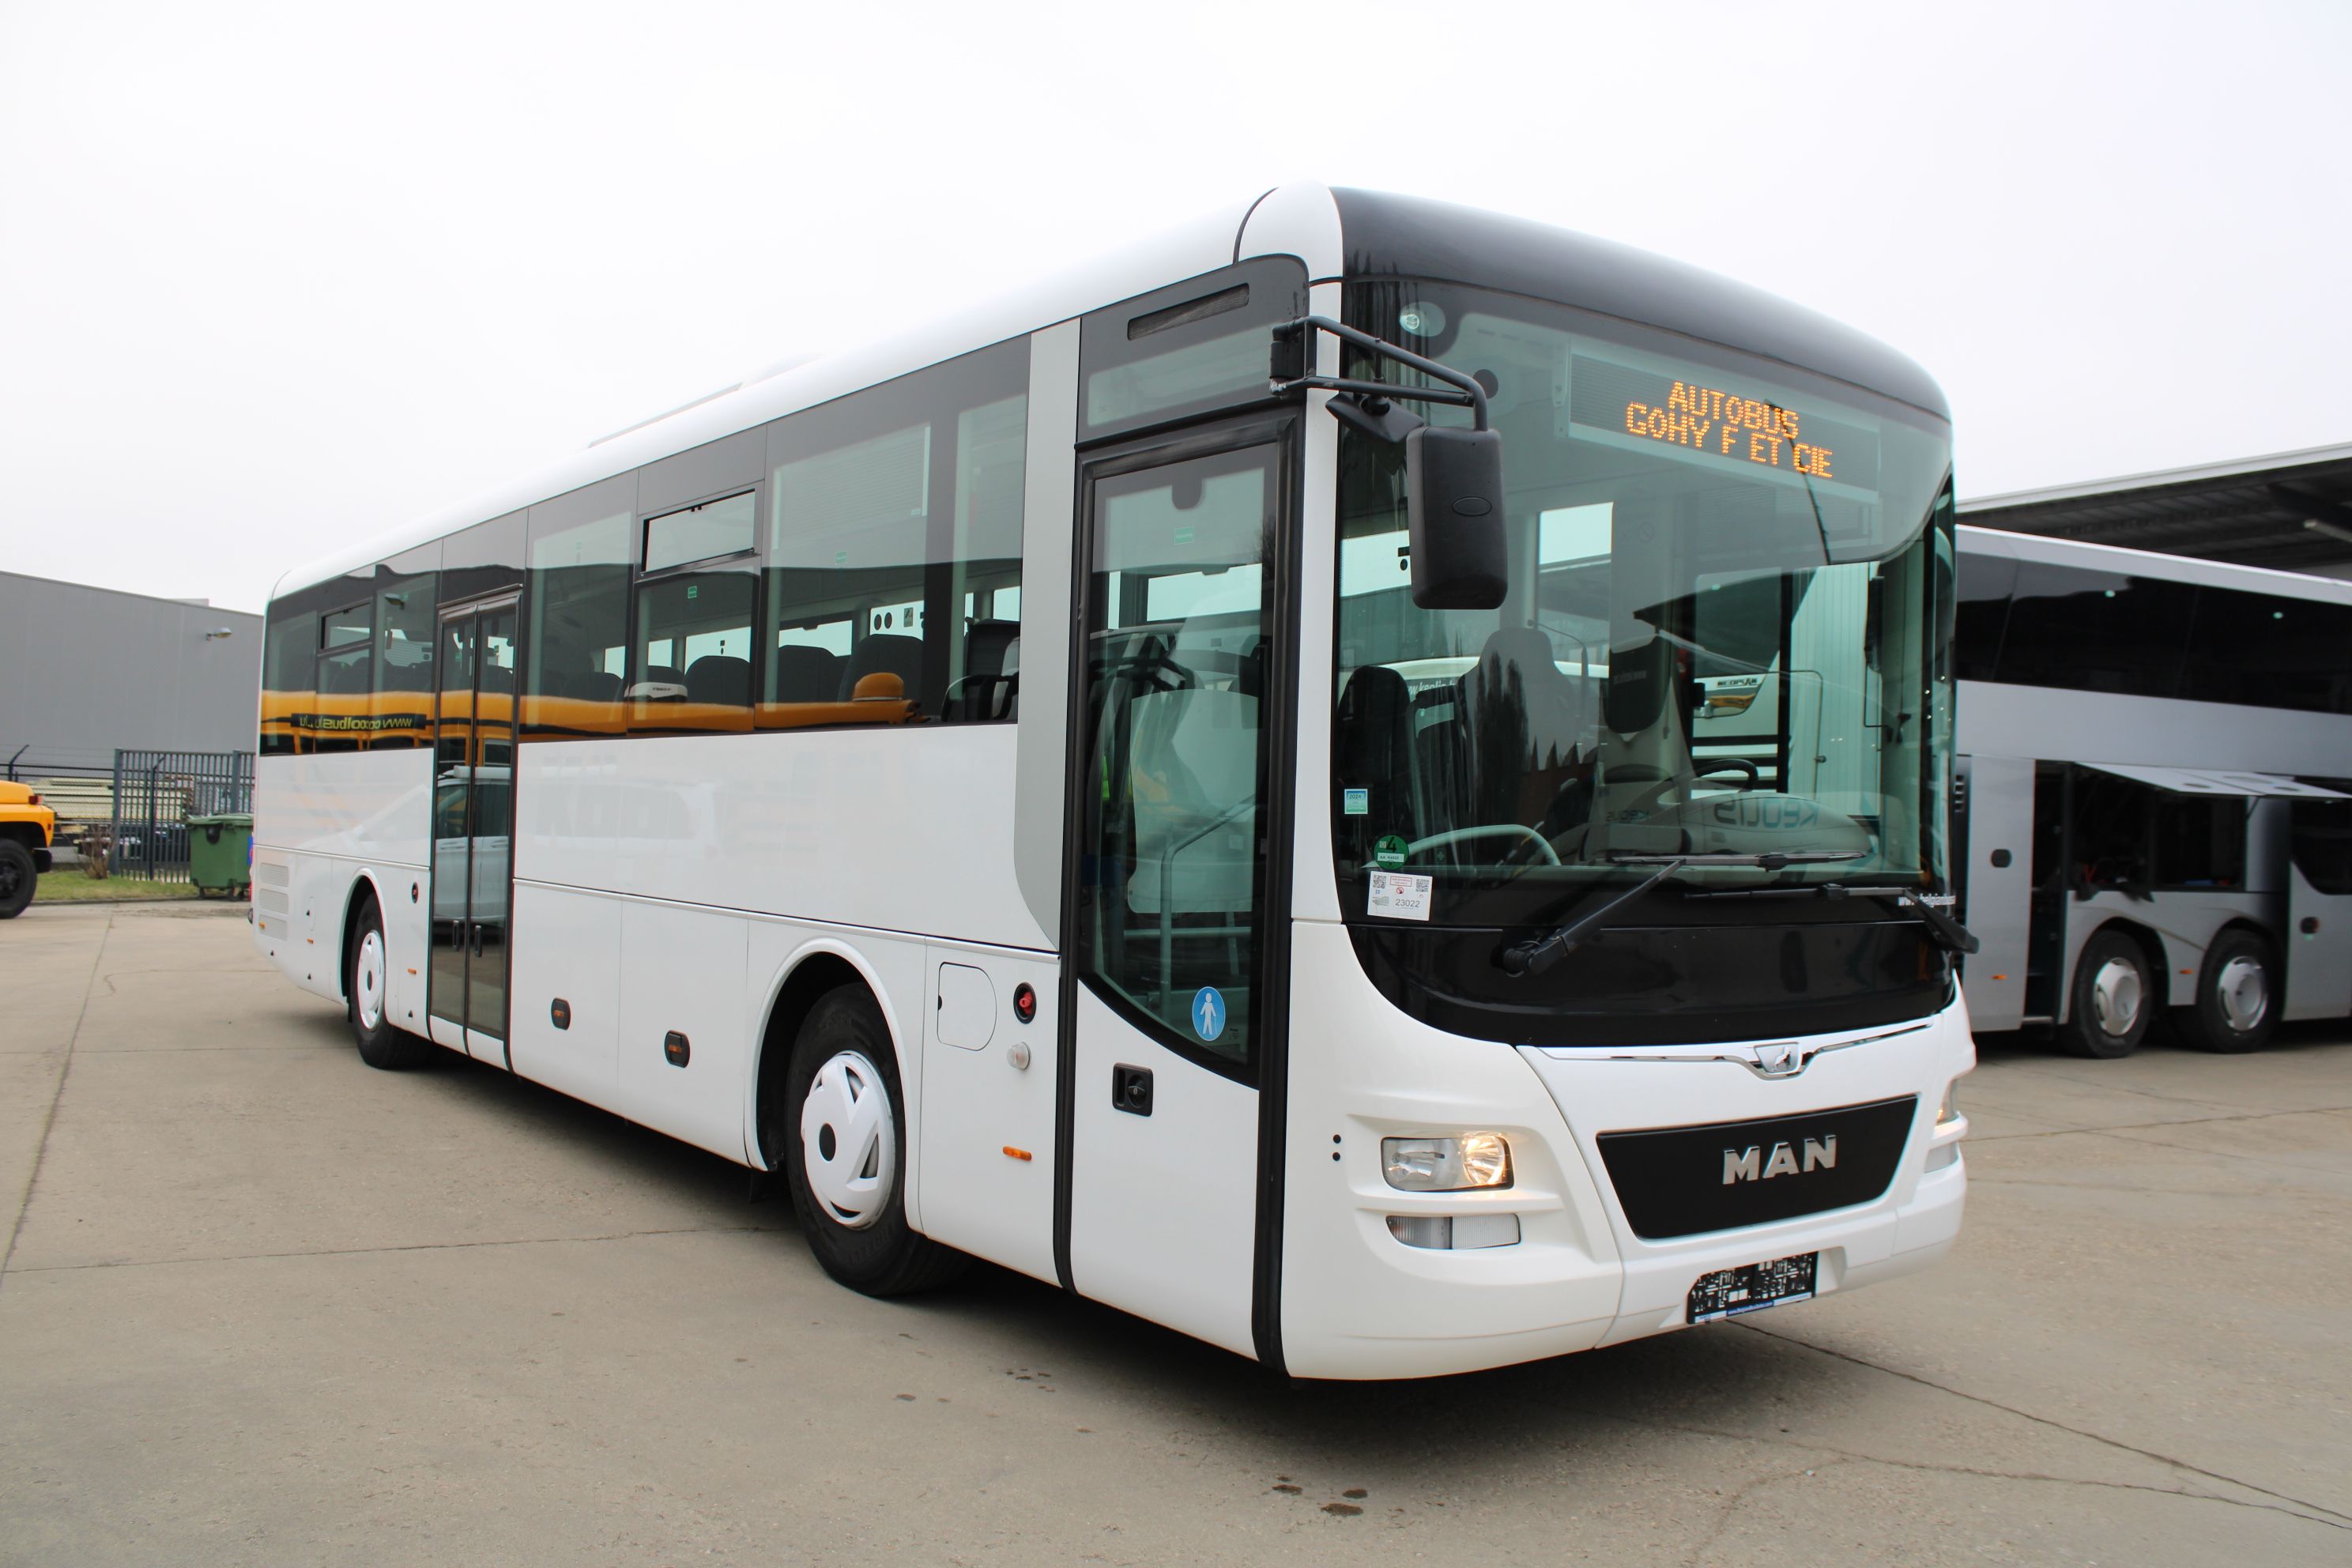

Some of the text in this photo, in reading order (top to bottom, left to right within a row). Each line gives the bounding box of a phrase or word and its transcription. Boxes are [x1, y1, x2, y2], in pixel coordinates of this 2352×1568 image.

[1668, 381, 1800, 439] AUTOBUS
[1626, 401, 1834, 479] GOHY F ET CIE
[1386, 836, 1397, 853] 4
[1395, 899, 1421, 908] 23022
[1723, 1135, 1836, 1185] MAN
